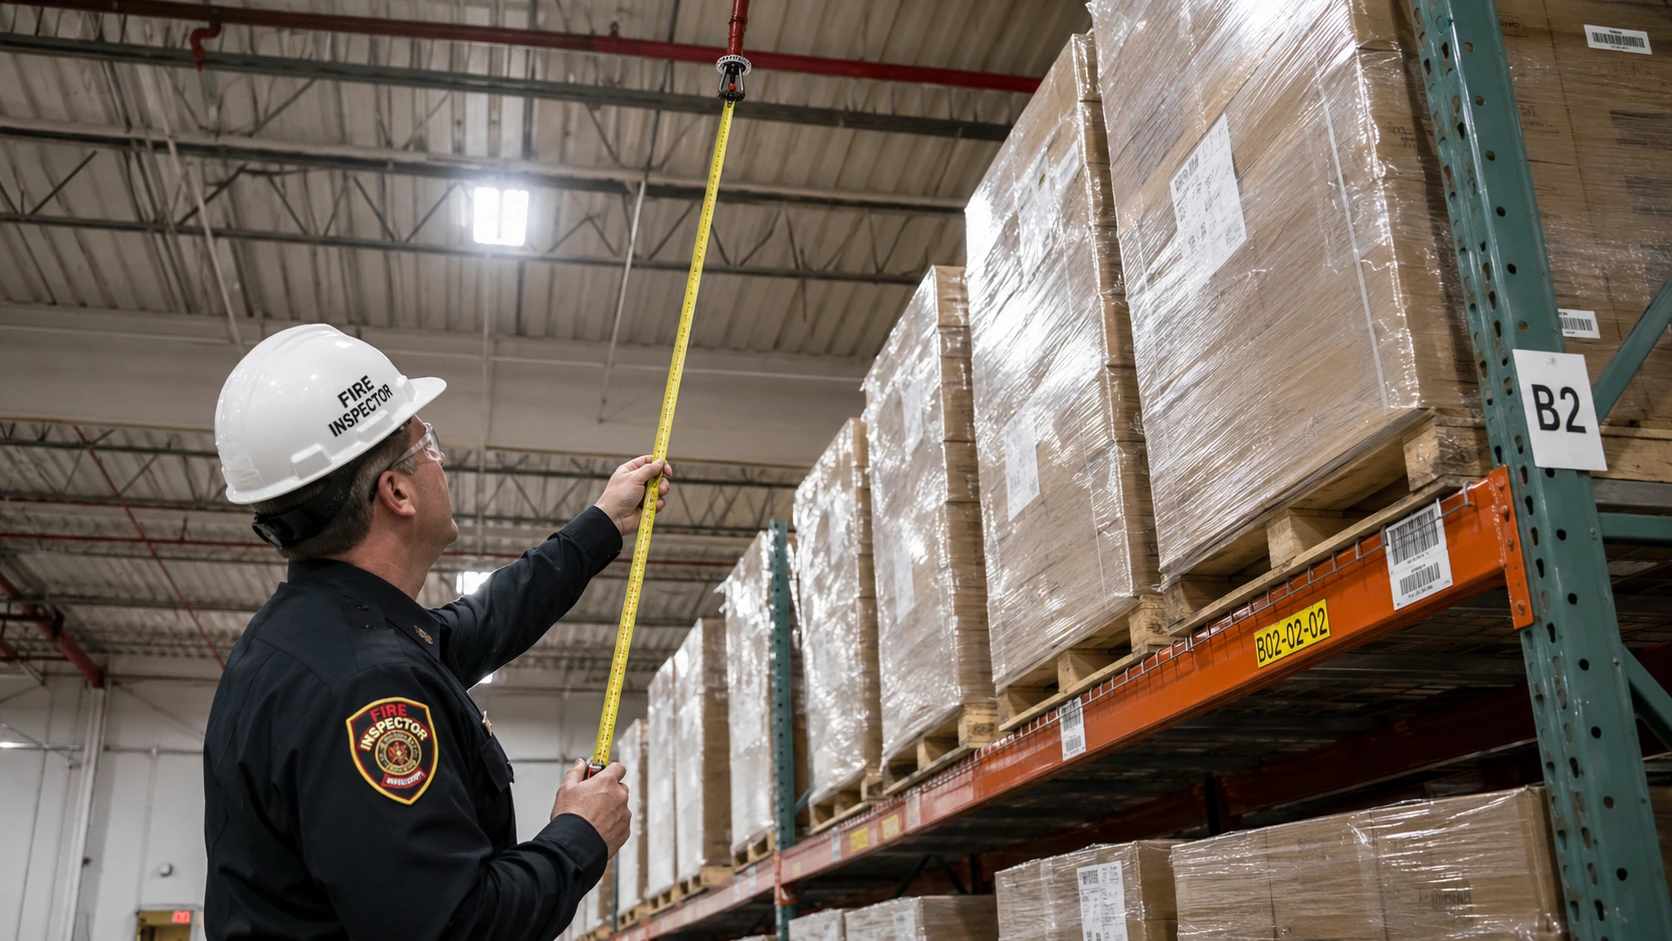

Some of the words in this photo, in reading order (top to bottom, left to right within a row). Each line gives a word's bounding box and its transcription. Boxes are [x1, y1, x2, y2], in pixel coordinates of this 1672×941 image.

[328, 383, 393, 438] INSPECTOR
[337, 375, 375, 409] FIRE
[1531, 383, 1587, 434] B2
[1256, 607, 1328, 663] B02-02-02
[360, 716, 428, 752] INSPECTOR
[369, 704, 407, 723] FIRE
